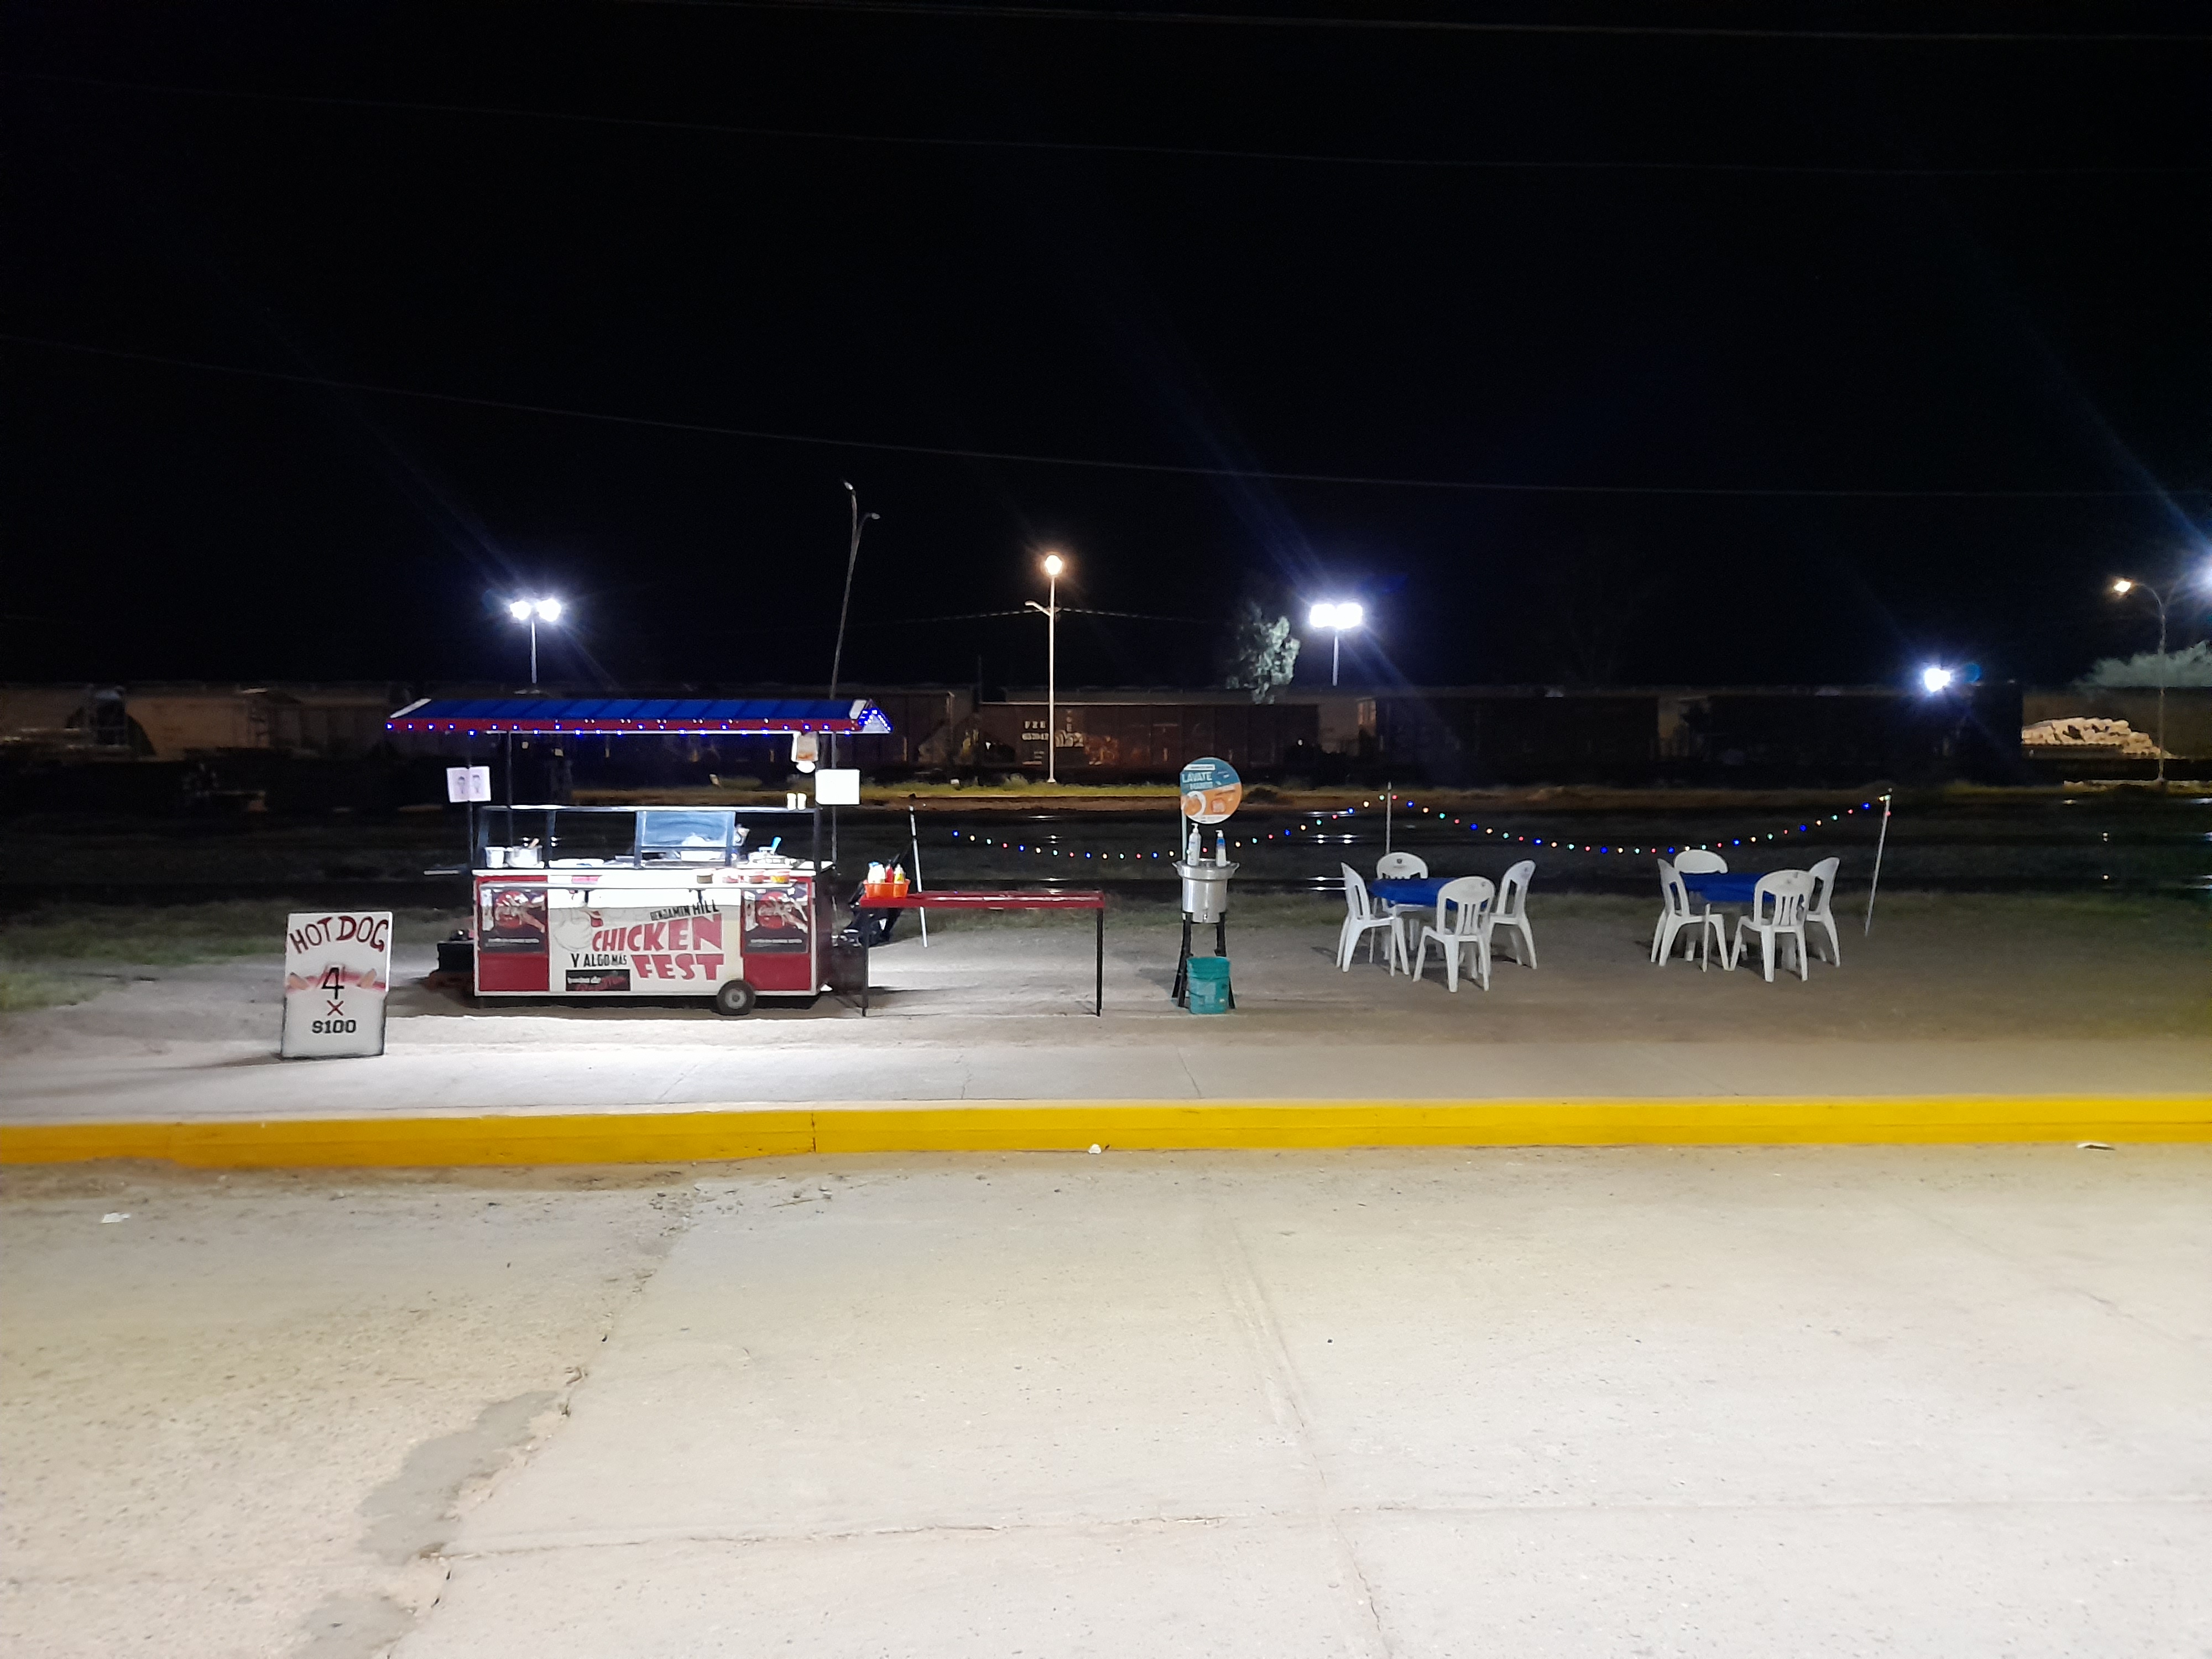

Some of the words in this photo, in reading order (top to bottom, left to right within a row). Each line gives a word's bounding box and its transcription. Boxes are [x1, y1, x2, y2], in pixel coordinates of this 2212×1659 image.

[692, 899, 719, 915] HILL
[289, 916, 333, 954] HOT
[336, 916, 388, 952] DOG
[592, 913, 722, 952] CHICKEN
[571, 953, 580, 968] Y
[583, 953, 609, 967] ALGO
[630, 953, 724, 980] FEST
[321, 967, 345, 1000] 4
